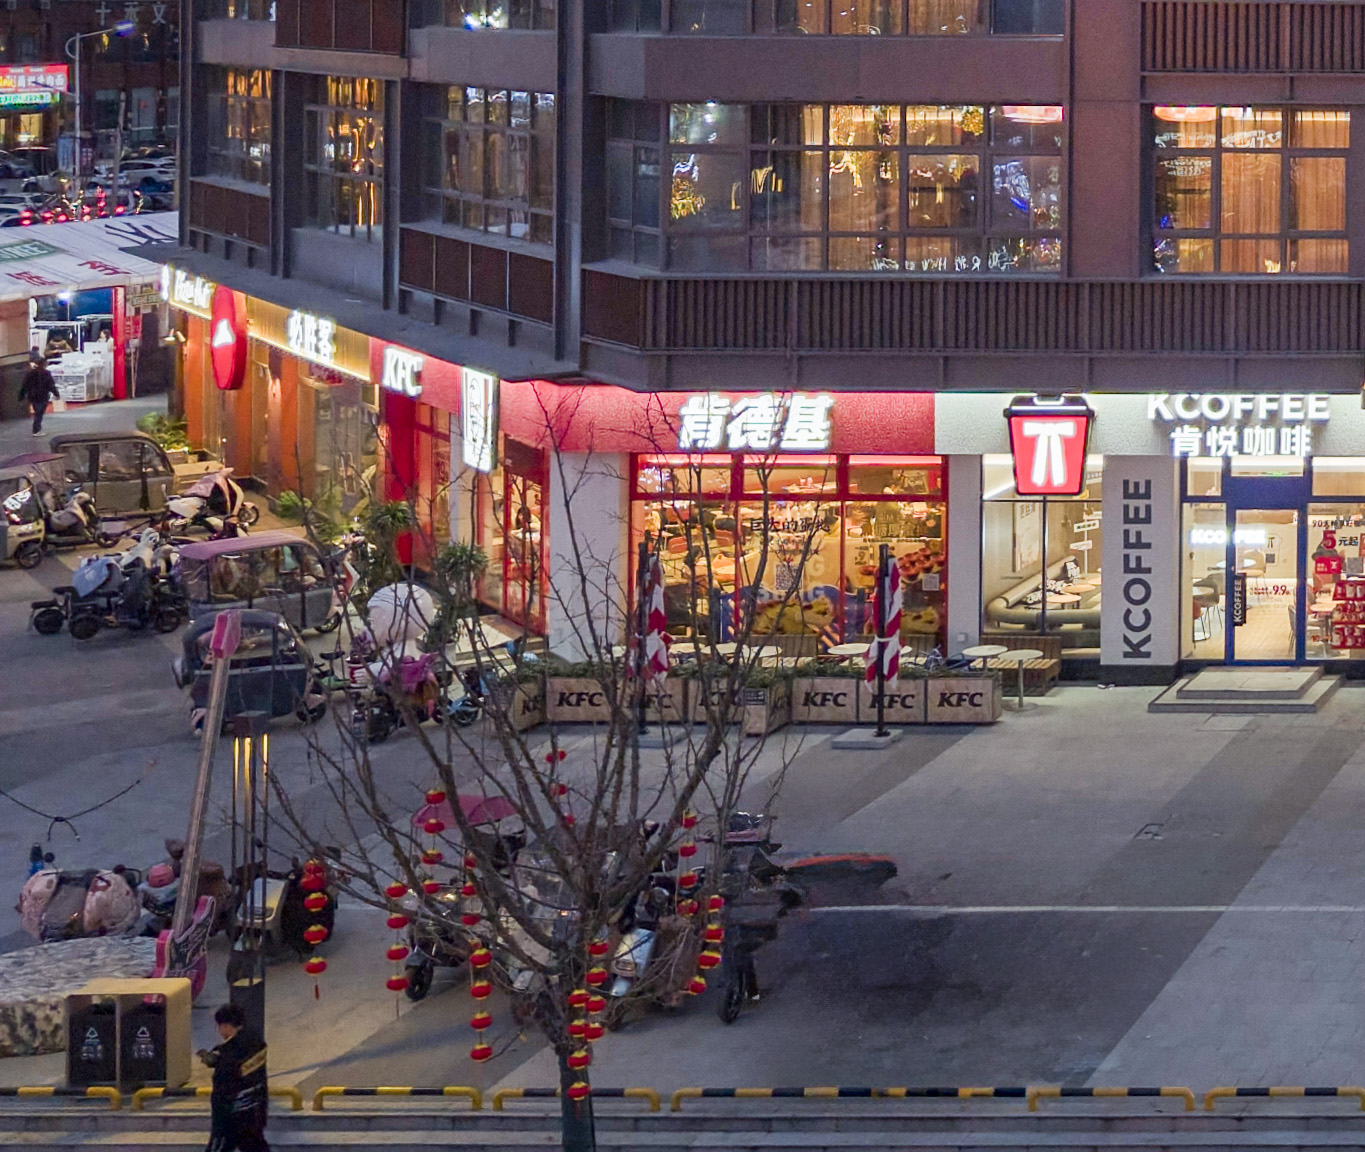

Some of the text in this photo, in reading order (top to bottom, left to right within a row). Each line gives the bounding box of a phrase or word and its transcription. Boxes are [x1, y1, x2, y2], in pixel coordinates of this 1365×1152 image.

[382, 347, 423, 398] KFC
[679, 394, 835, 449] 肯德基
[1147, 394, 1330, 421] KCOFFEE
[1170, 424, 1312, 457] 肯悦咖啡
[1123, 479, 1152, 659] KCOFFEE
[1233, 579, 1242, 623] KCOFFEE
[556, 690, 603, 708] KFC
[802, 691, 848, 707] KFC
[937, 691, 983, 708] KFC
